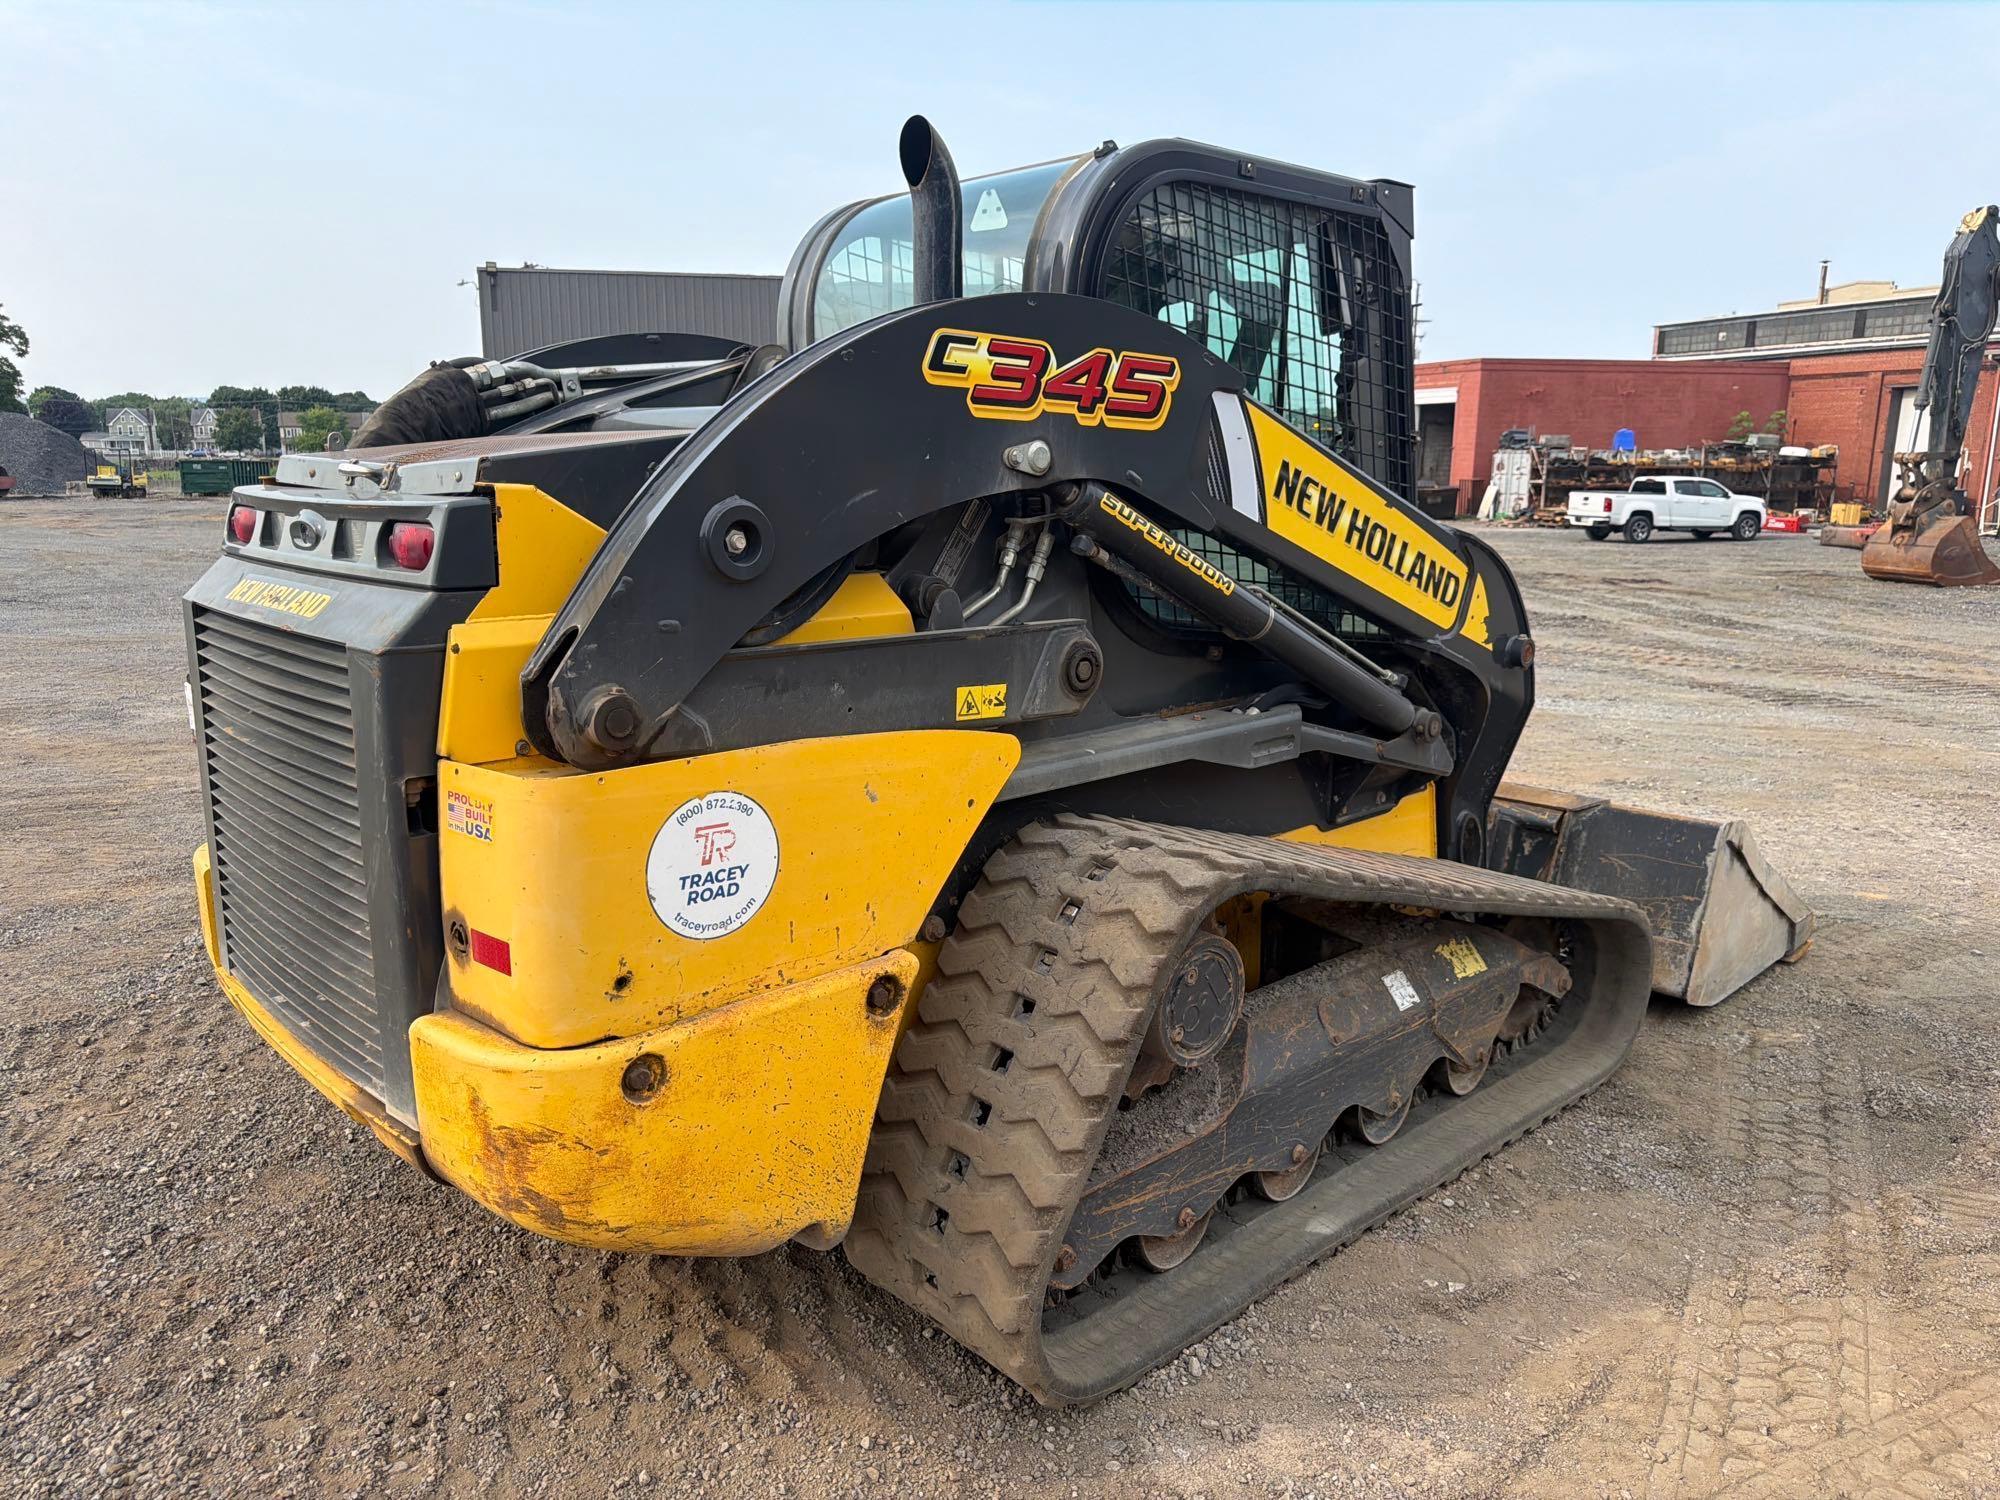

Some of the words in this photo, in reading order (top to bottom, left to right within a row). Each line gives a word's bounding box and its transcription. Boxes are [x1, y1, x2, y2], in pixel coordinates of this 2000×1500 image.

[924, 329, 1180, 430] C345
[1273, 458, 1347, 535] NEW
[1344, 507, 1460, 609] HOLLAND
[225, 578, 268, 604] NEW
[254, 584, 332, 619] HOLLAND
[465, 808, 493, 825] BUILT
[676, 802, 703, 827] (800)
[447, 821, 454, 829] in
[454, 823, 465, 832] the
[465, 820, 493, 842] USA
[679, 864, 750, 891] TRACEY
[687, 882, 740, 906] ROAD
[673, 896, 757, 933] traceyroad.com
